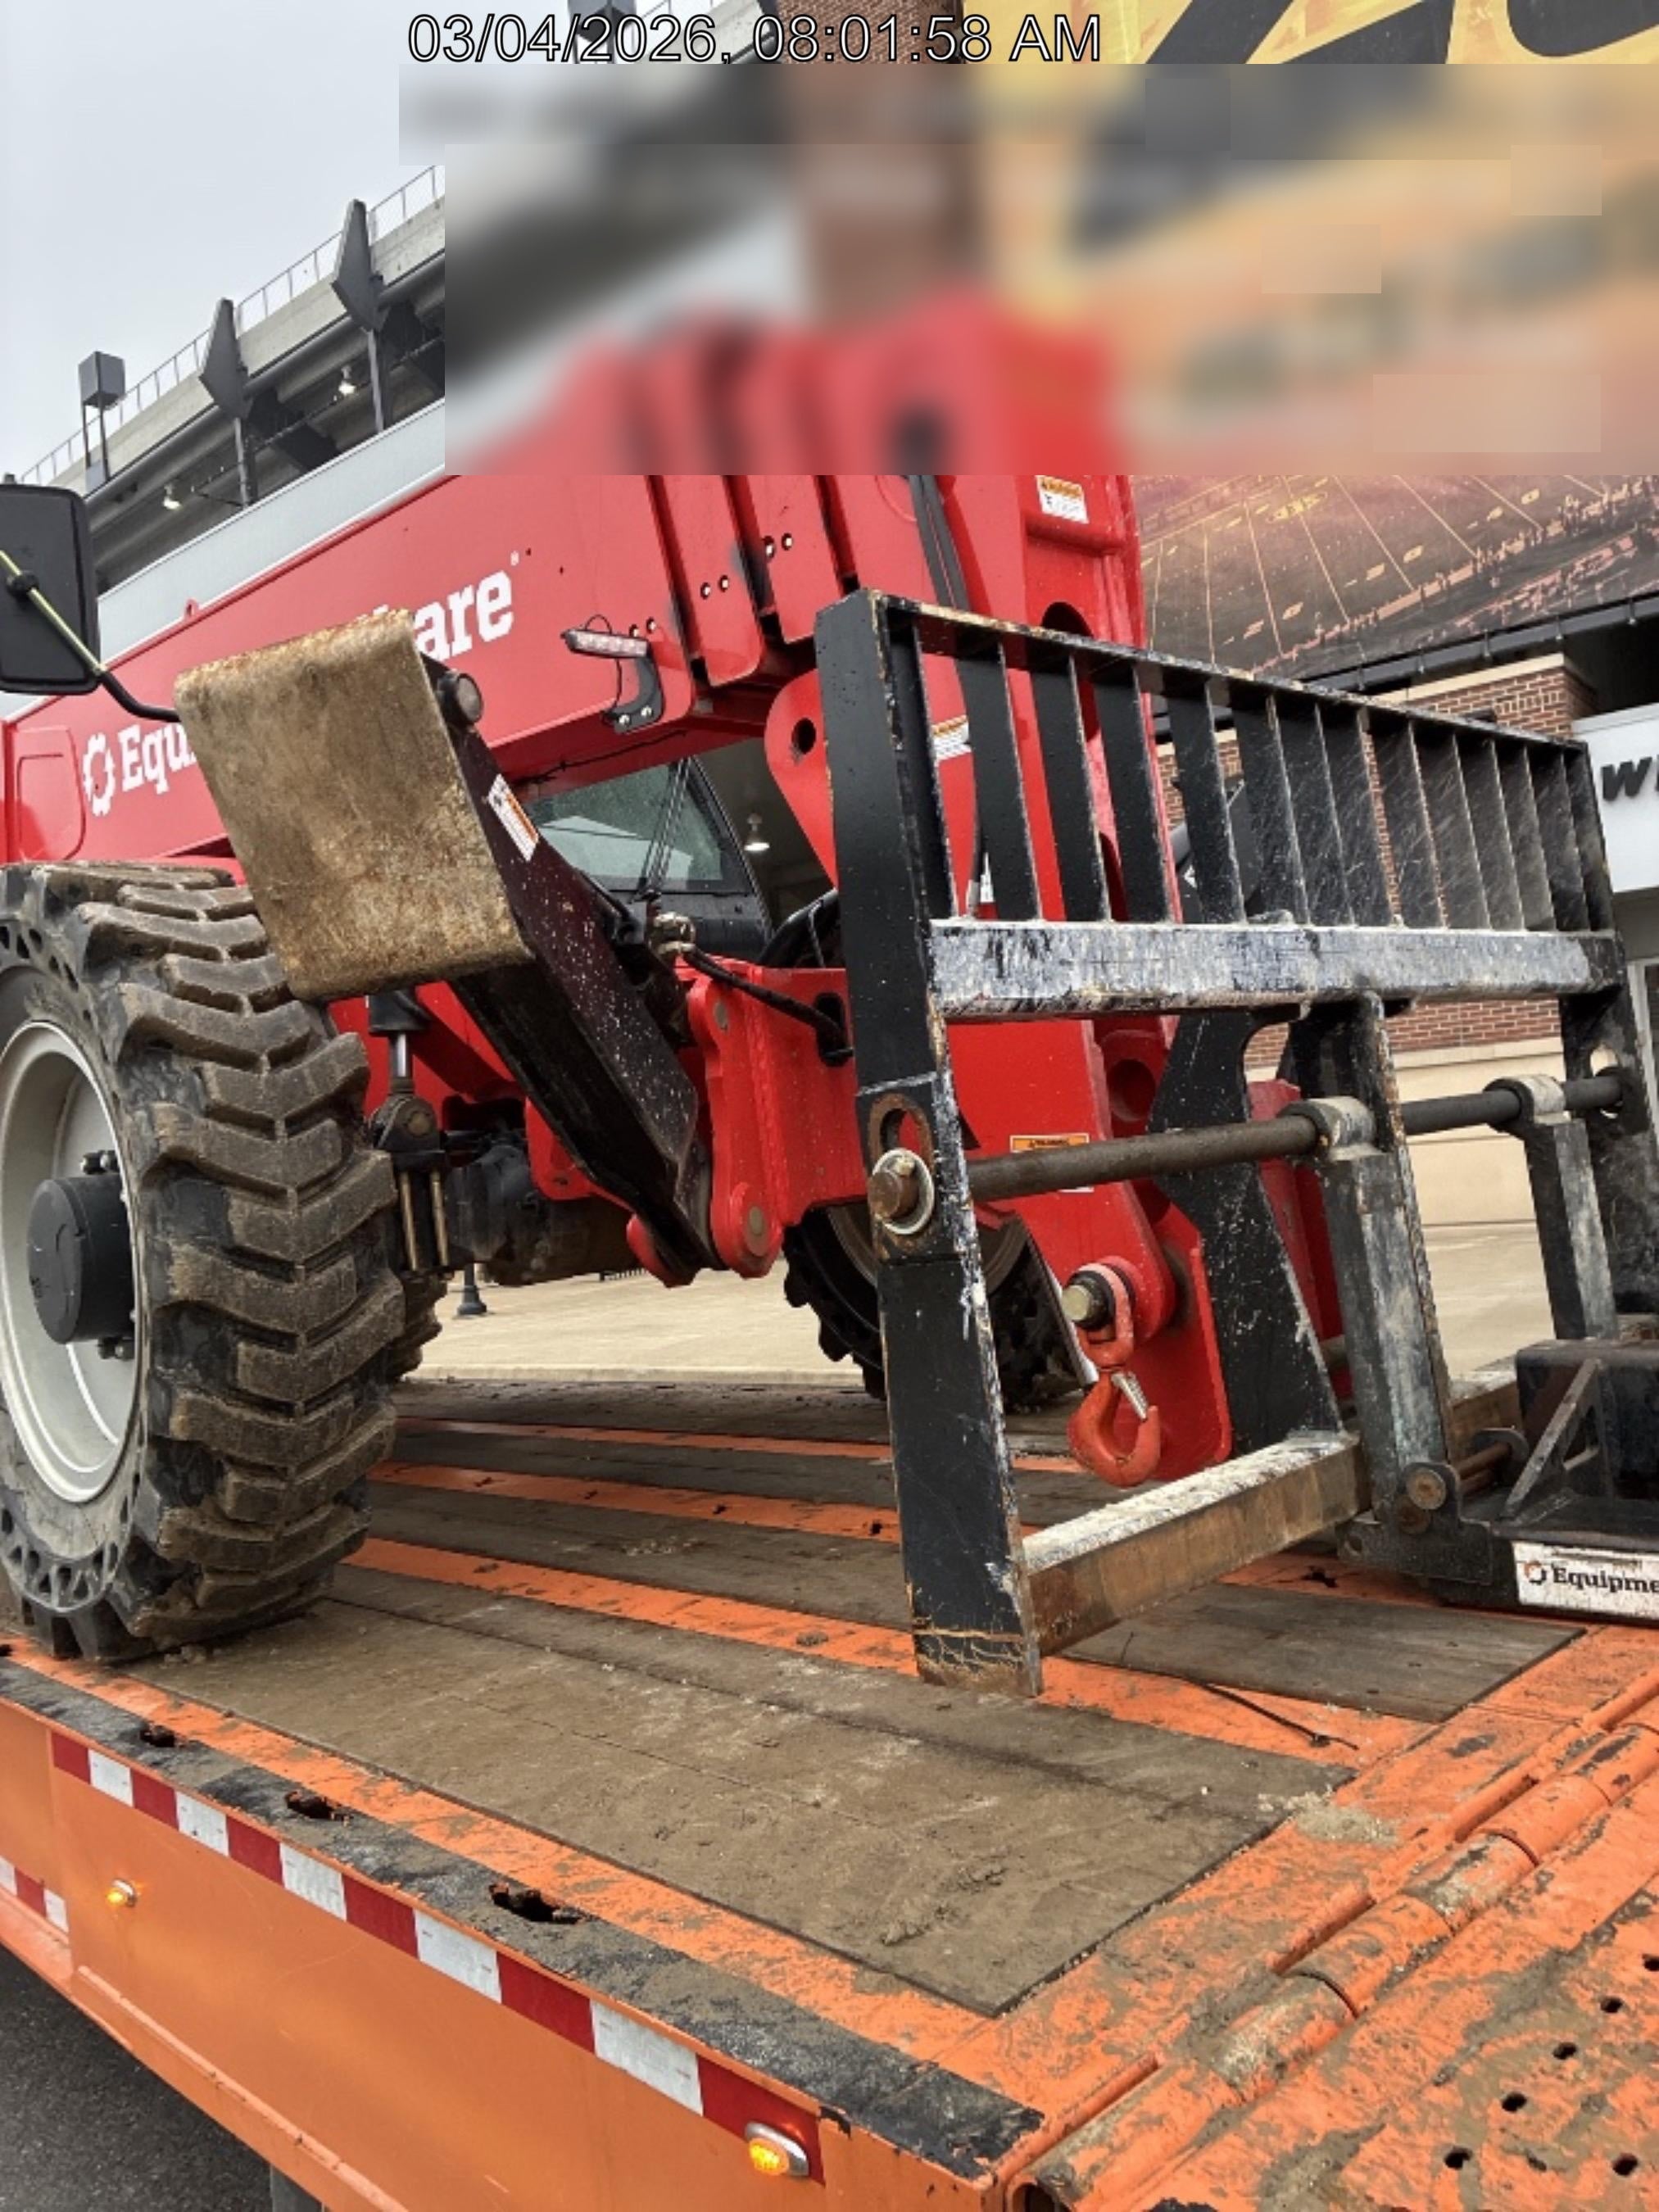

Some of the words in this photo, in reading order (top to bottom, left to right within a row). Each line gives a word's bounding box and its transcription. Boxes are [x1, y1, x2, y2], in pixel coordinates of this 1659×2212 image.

[117, 724, 197, 795] Equ
[412, 569, 514, 662] are
[1600, 754, 1659, 802] W
